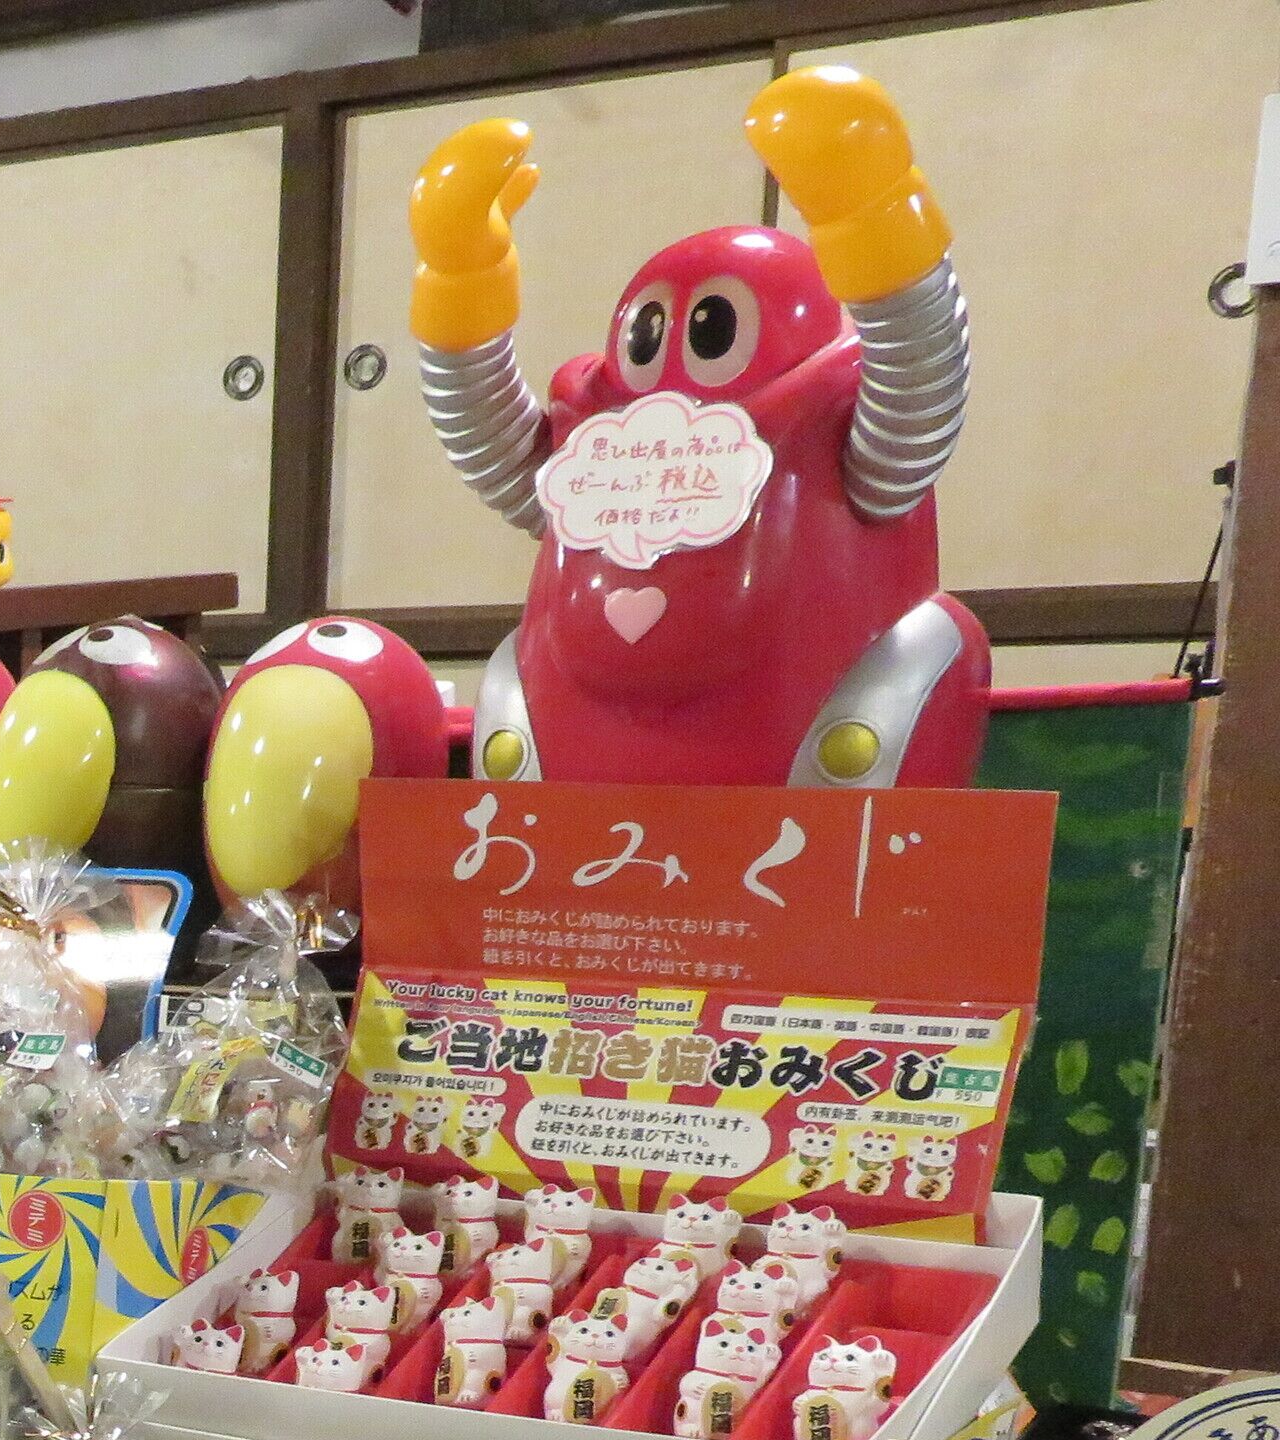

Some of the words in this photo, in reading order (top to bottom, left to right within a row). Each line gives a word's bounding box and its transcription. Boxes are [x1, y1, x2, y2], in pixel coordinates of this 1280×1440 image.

[453, 792, 921, 919] おみくじ
[387, 981, 428, 998] Your
[430, 984, 474, 1002] lucky
[481, 989, 507, 1001] cat
[513, 989, 566, 1005] knows
[572, 995, 613, 1010] your
[618, 996, 693, 1012] fortune!
